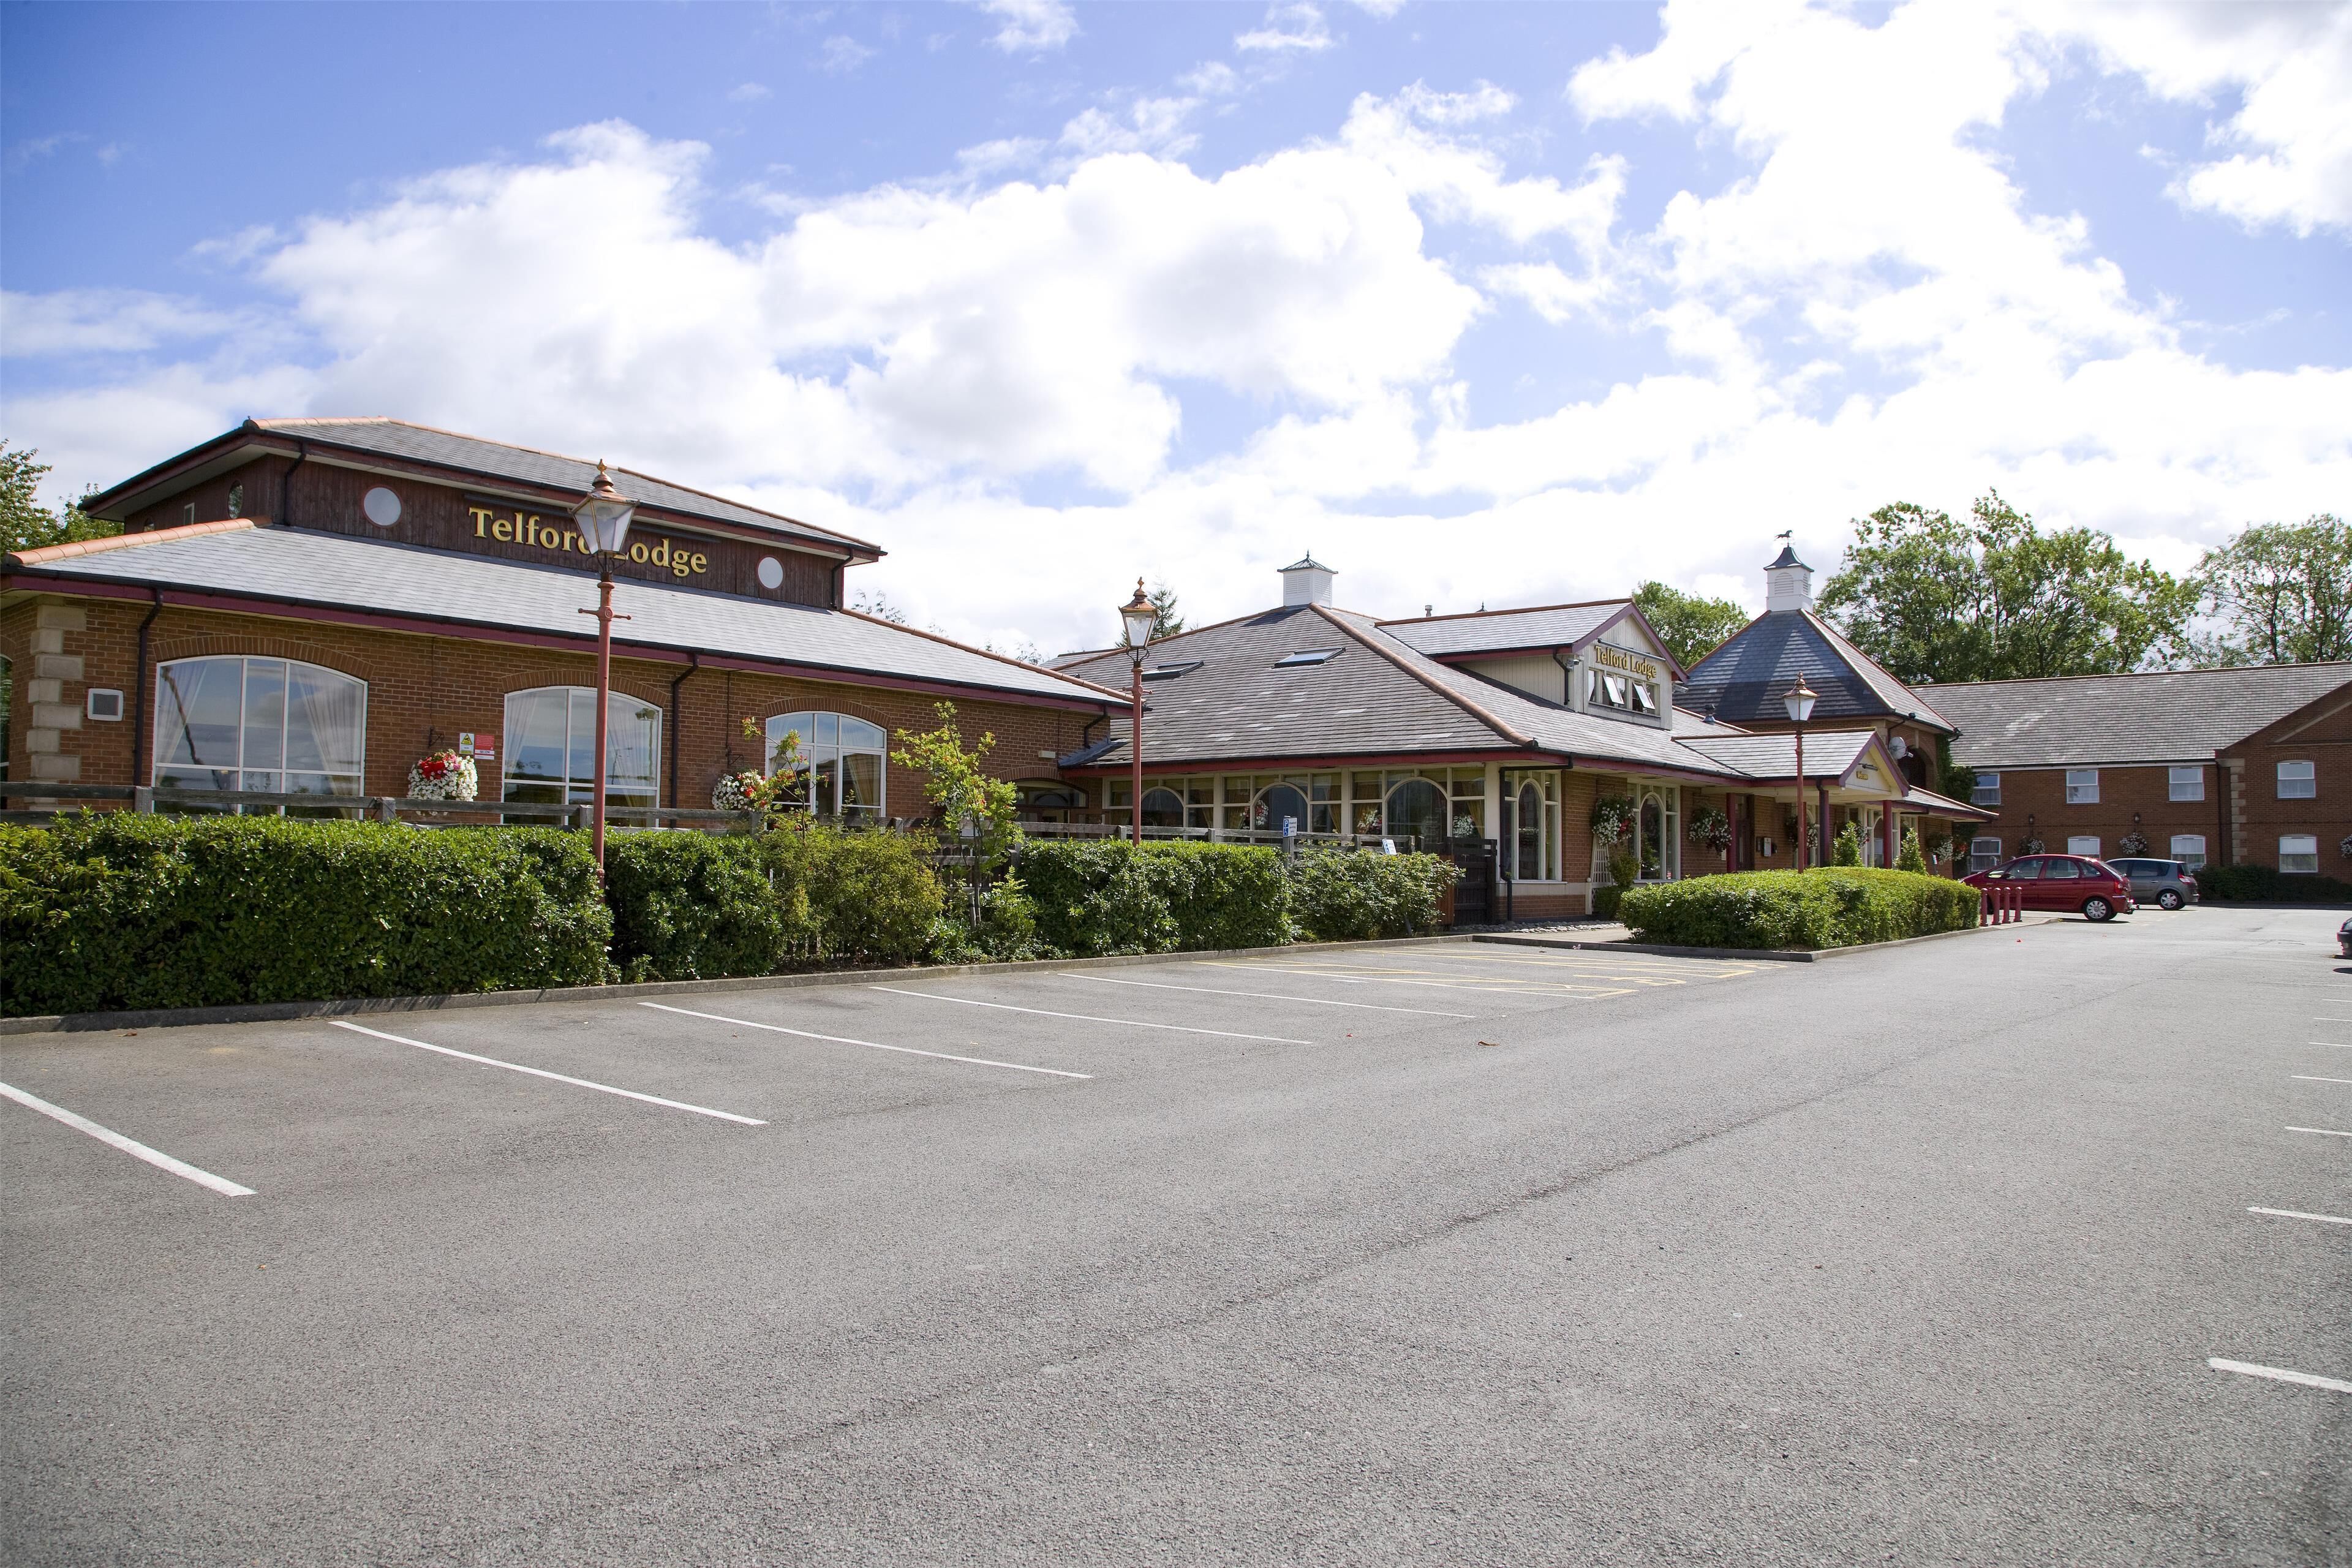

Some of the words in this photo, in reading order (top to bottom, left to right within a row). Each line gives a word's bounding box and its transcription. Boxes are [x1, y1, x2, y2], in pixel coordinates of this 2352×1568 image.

[612, 538, 707, 577] odge
[1594, 646, 1629, 670] Telford
[1630, 655, 1657, 680] Lodge
